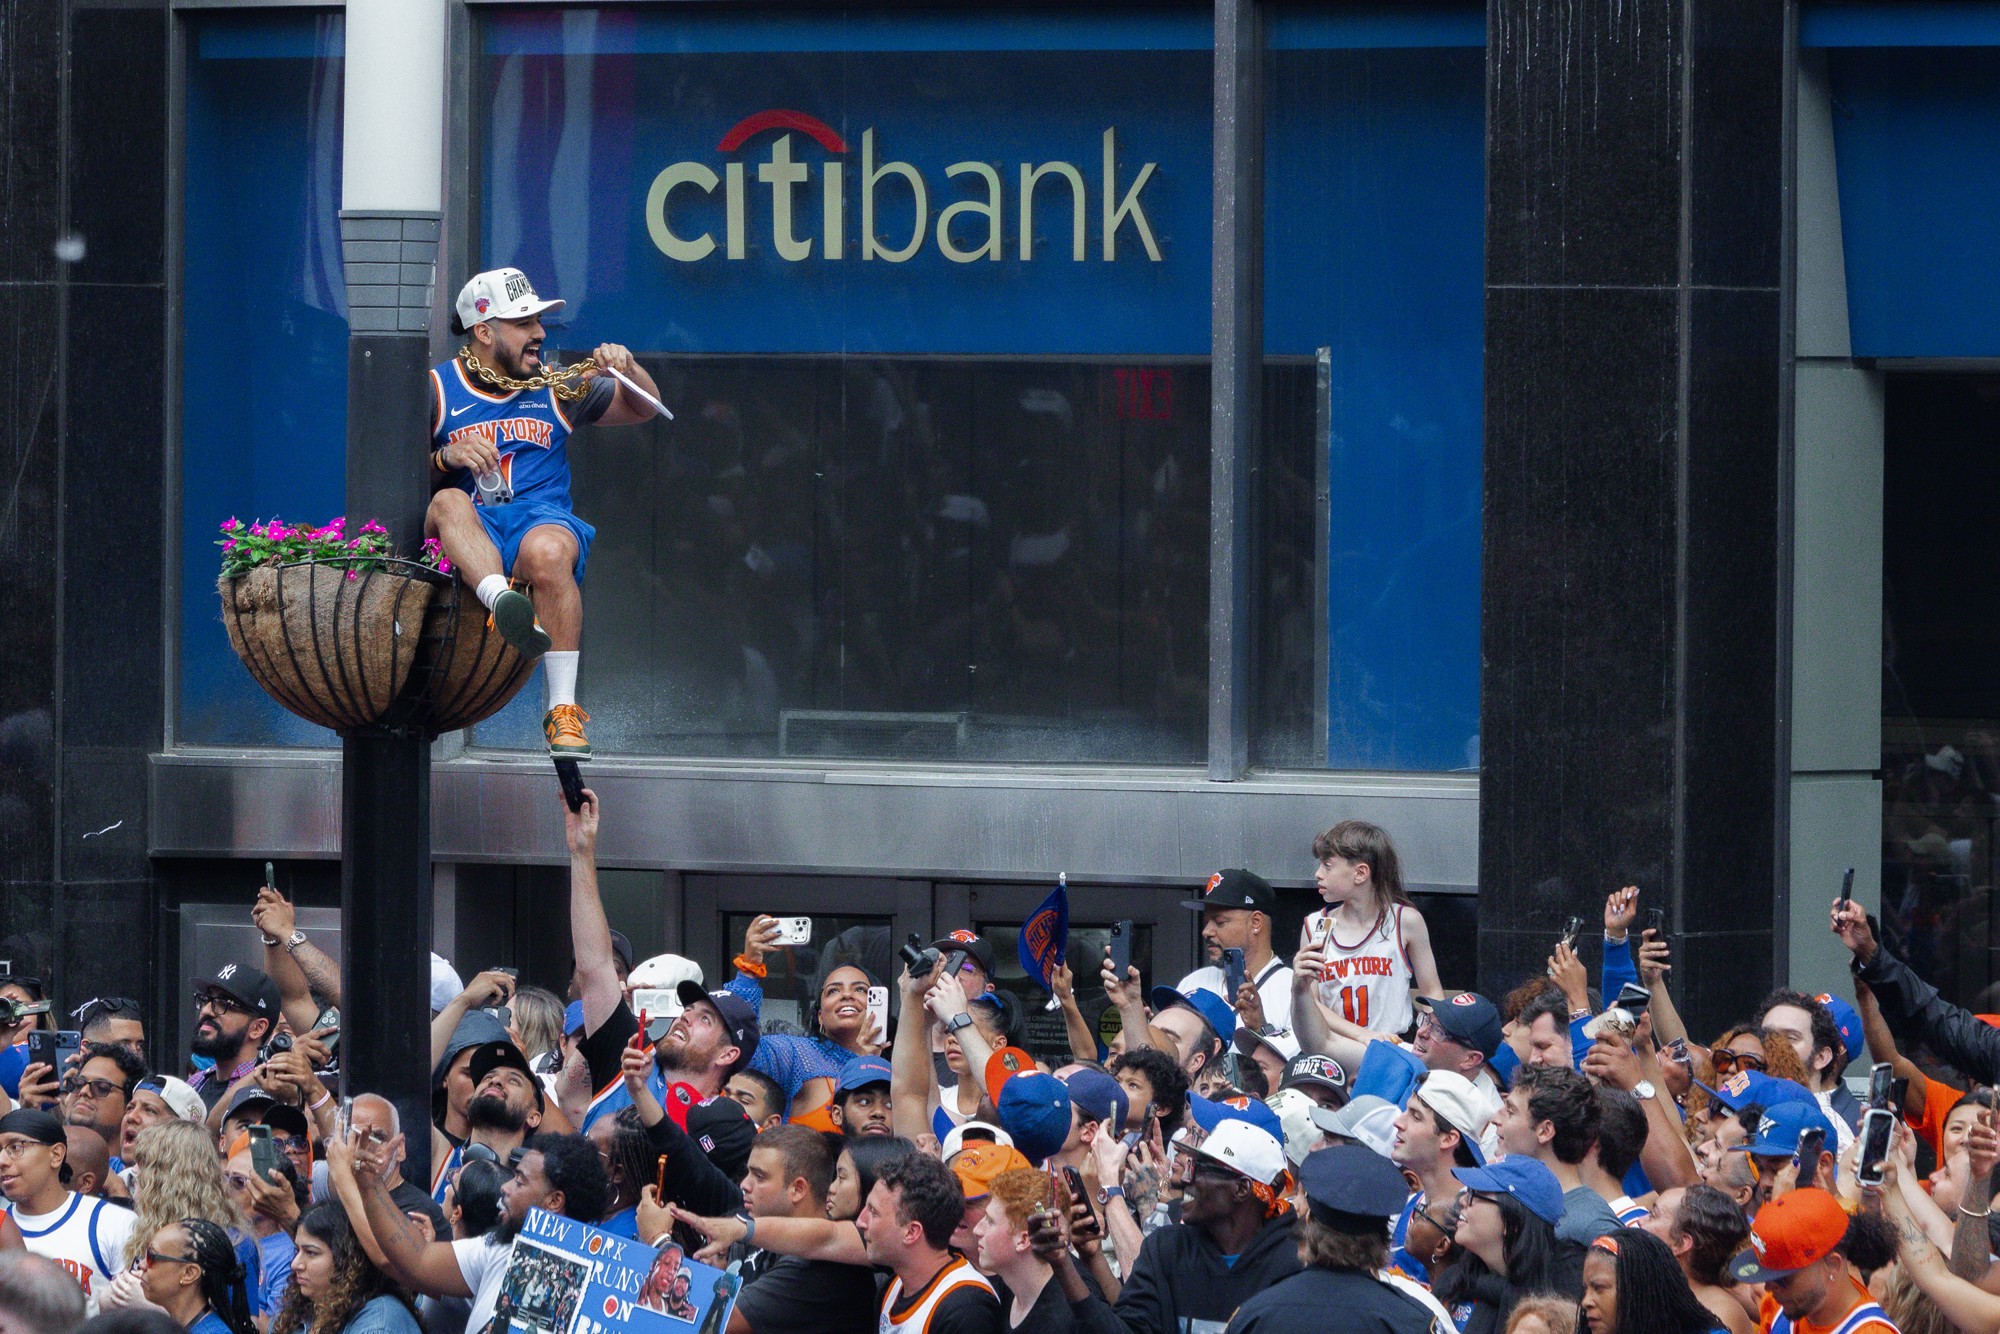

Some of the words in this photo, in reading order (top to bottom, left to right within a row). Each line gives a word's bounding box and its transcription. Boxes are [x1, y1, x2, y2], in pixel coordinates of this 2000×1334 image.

[646, 126, 1162, 263] citibank
[499, 417, 553, 450] YORK
[1351, 957, 1393, 977] YORK
[1340, 985, 1369, 1028] 11
[1101, 1023, 1123, 1031] CAUT
[1292, 1061, 1320, 1076] FINALS
[524, 1207, 572, 1242] NEW
[579, 1225, 628, 1262] YORK
[52, 1258, 94, 1297] RK
[590, 1260, 645, 1294] RUNS
[603, 1294, 637, 1323] ON
